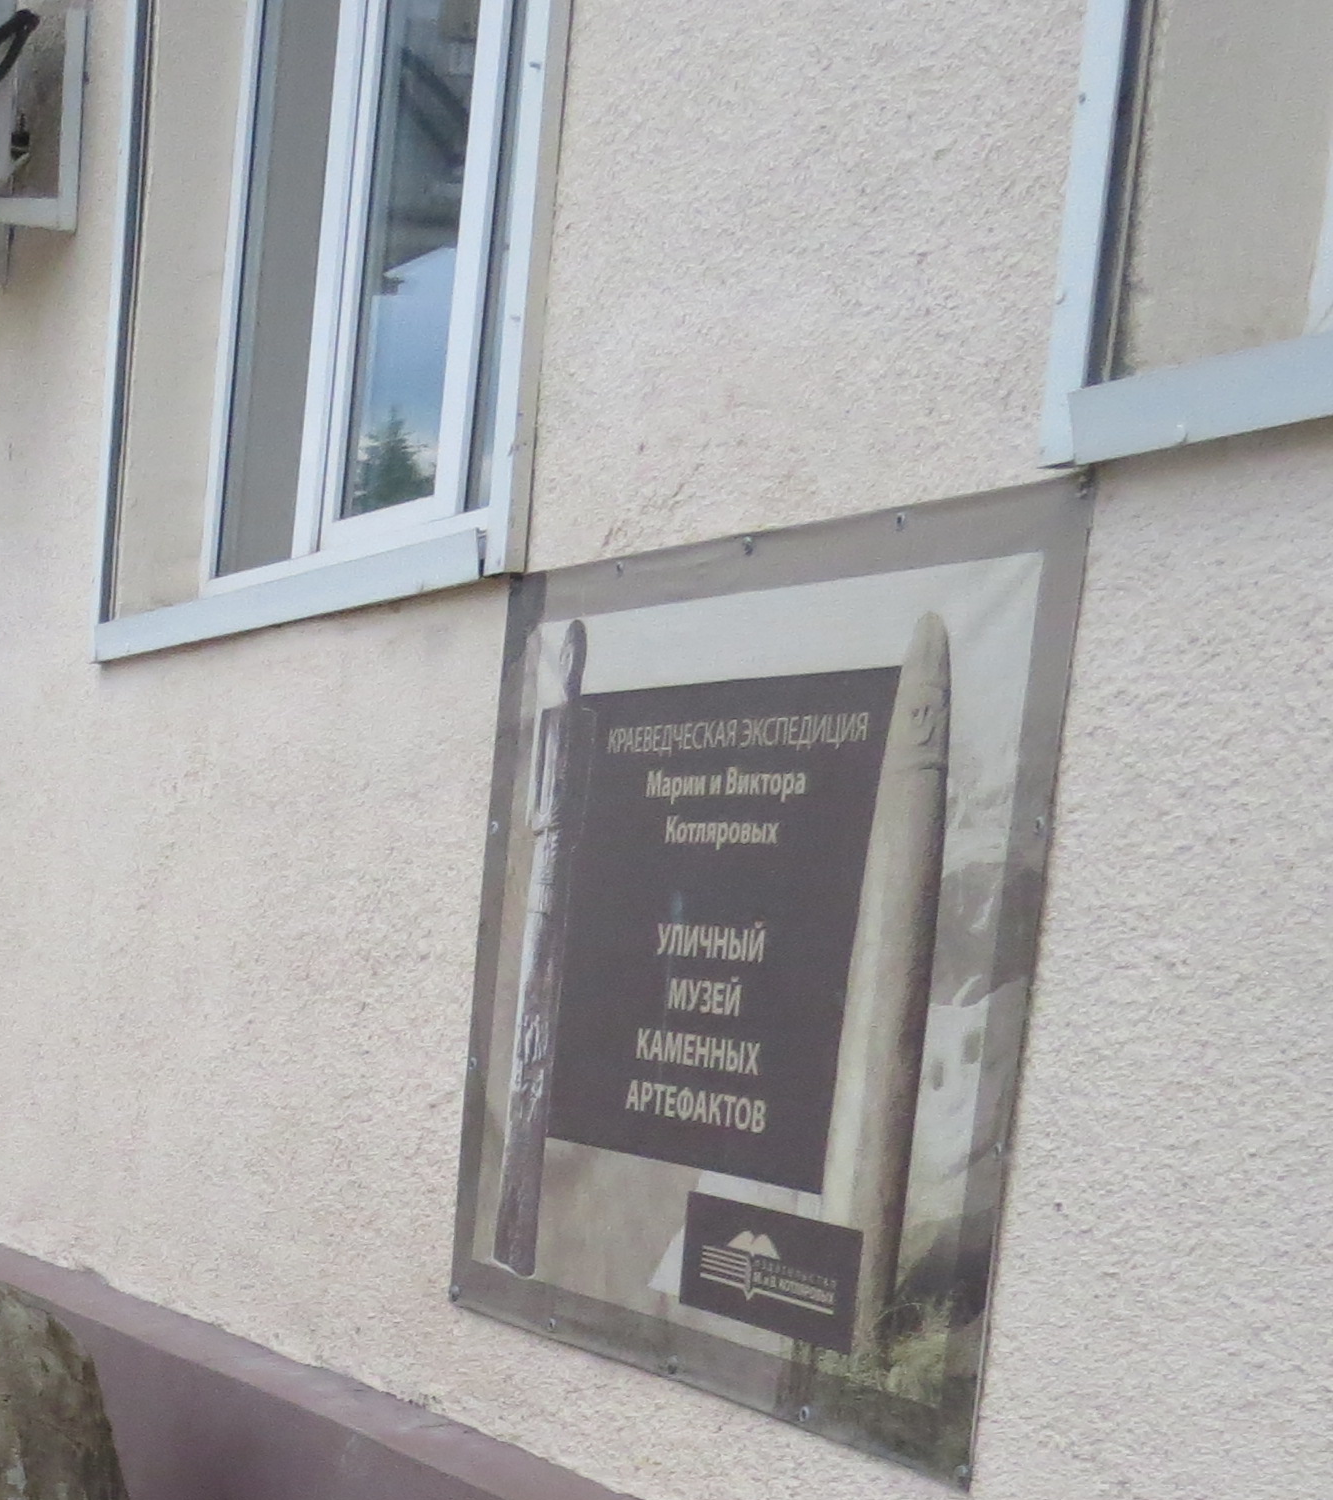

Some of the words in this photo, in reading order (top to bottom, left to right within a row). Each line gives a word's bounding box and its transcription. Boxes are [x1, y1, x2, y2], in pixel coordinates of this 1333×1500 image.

[607, 719, 738, 757] КРАЕВЕДЧЕСКАЯ
[740, 711, 869, 750] ЭКСПЕДИЦИЯ
[645, 768, 705, 804] Марии
[710, 774, 722, 796] и
[726, 767, 806, 803] Виктора
[664, 815, 780, 850] Котляровых
[656, 920, 766, 963] УЛИЧНЫЙ
[667, 976, 743, 1017] МУЗЕЙ
[635, 1027, 761, 1076] КАМЕННЫХ
[625, 1079, 767, 1133] АРТЕФАКТОВ
